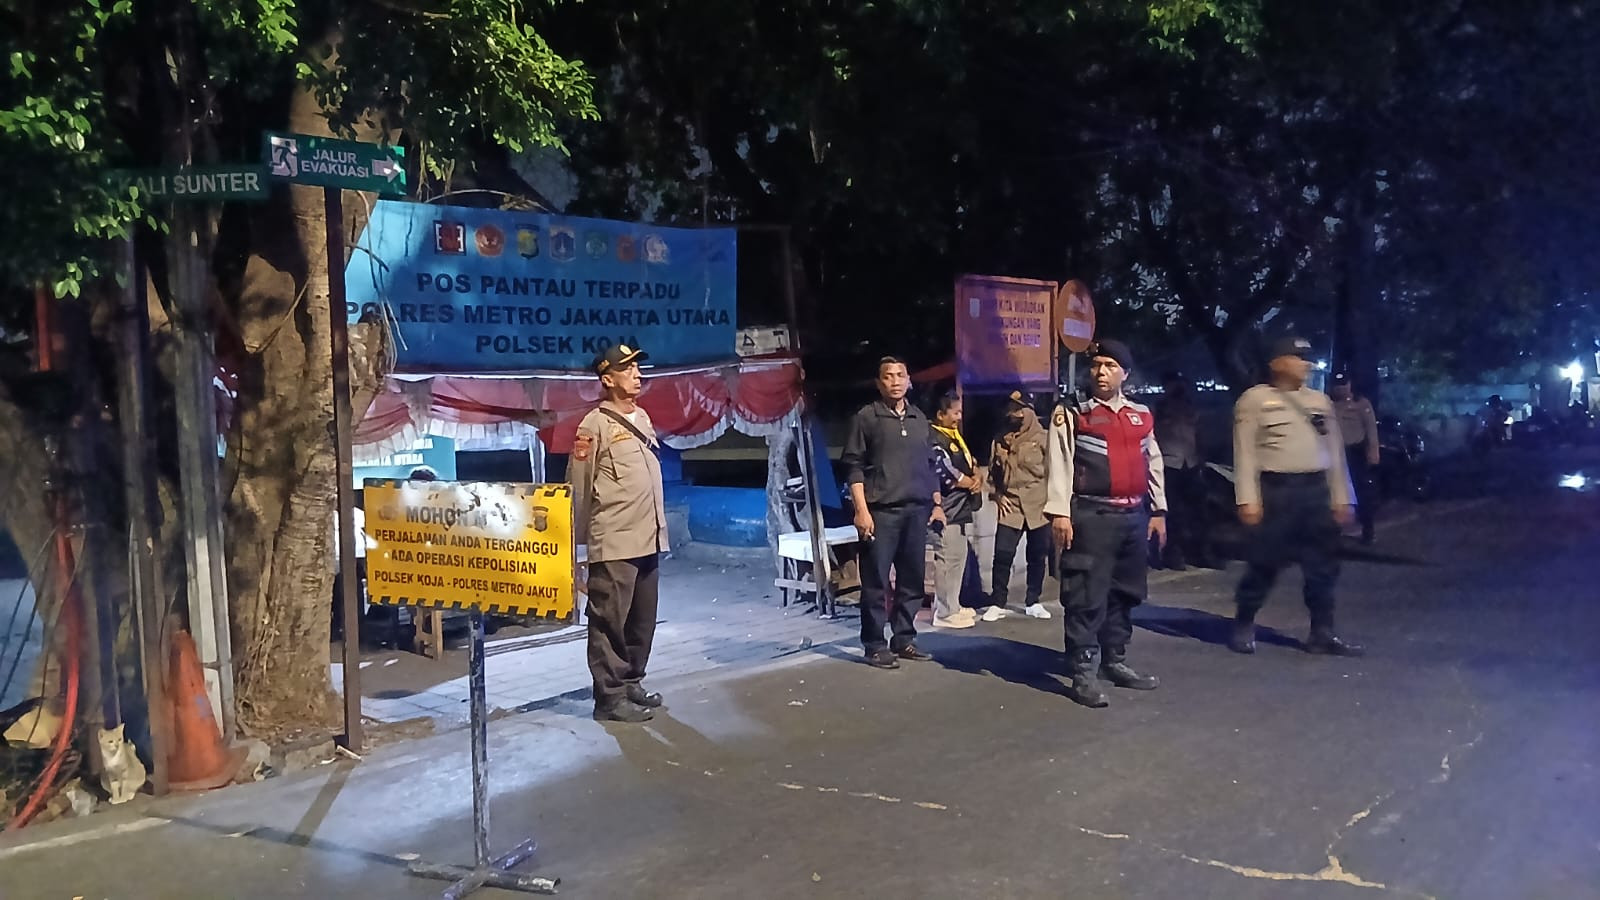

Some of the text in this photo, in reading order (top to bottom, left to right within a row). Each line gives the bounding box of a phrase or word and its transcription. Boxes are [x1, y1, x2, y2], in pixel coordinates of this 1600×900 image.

[312, 149, 358, 164] JALUR
[301, 160, 369, 179] EVAKUASI
[118, 172, 260, 195] KALI SUNTER
[416, 272, 680, 300] POS PANTAU TERPADU
[464, 304, 550, 325] METRO
[560, 305, 660, 326] JAKARTA
[667, 306, 730, 326] UTARA
[476, 335, 574, 354] POLSEK
[1010, 333, 1022, 345] DAN
[375, 528, 559, 556] PERJALANAN ANDA TERGANGGU
[391, 549, 537, 574] ADA OPERASI KEPOLISIAN
[374, 570, 413, 584] POLSEK
[417, 574, 444, 587] KOJA
[453, 577, 489, 592] POLRES
[491, 580, 524, 596] METRO
[526, 584, 559, 599] JAKUT
